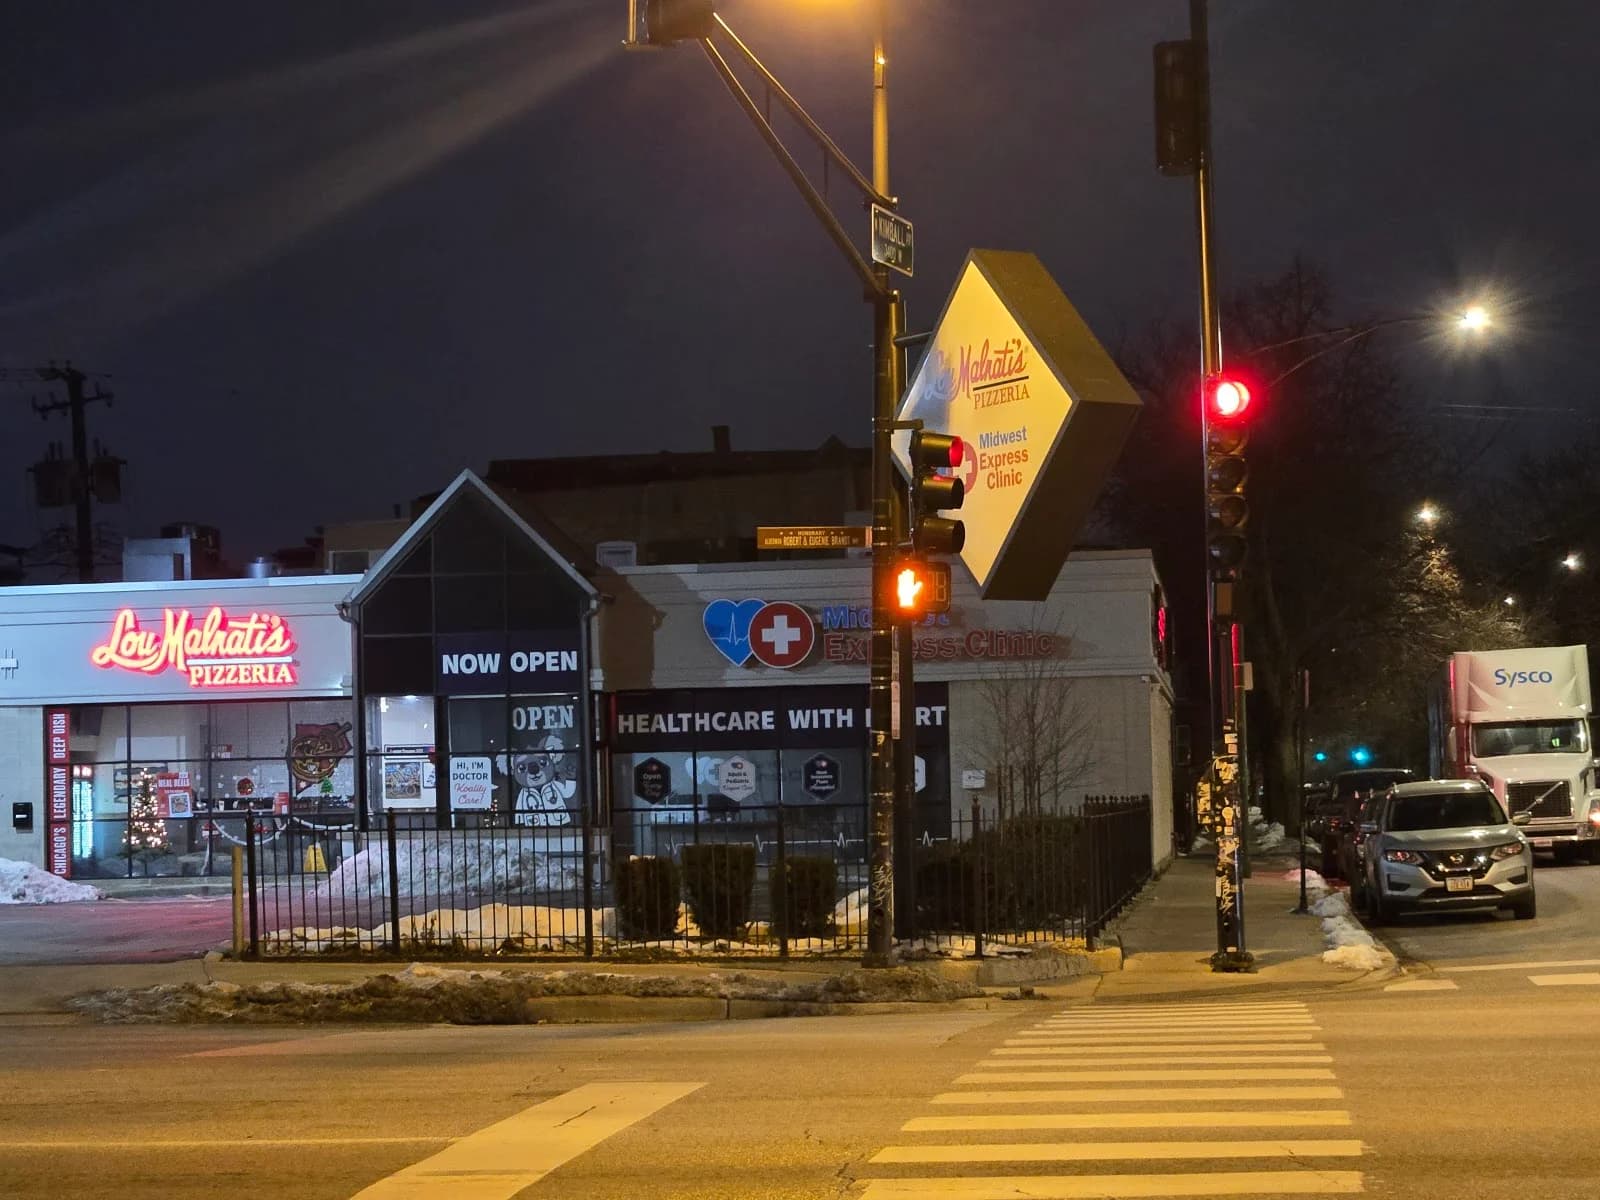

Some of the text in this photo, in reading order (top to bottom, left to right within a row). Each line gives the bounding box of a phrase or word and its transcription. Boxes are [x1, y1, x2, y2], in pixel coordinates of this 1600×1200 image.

[879, 216, 905, 247] KIMBALL
[955, 338, 1028, 399] Malnati's
[973, 383, 1030, 410] PIZZERIA
[979, 426, 1027, 449] Midwest
[979, 449, 1029, 471] Express
[987, 469, 1023, 490] Clinic
[92, 606, 292, 672] Lou Malnati's
[964, 629, 1055, 658] Clinic
[442, 651, 578, 674] NOW OPEN
[190, 664, 294, 686] PIZZERIA
[1494, 668, 1553, 688] Sysco
[512, 705, 574, 730] OPEN
[617, 710, 775, 734] HEALTHCARE
[788, 708, 853, 728] WITH
[452, 772, 489, 781] DOCTOR
[456, 761, 484, 771] HI, I'M
[53, 713, 67, 876] CHICAGO'S LEGENDARY DEEP DISH
